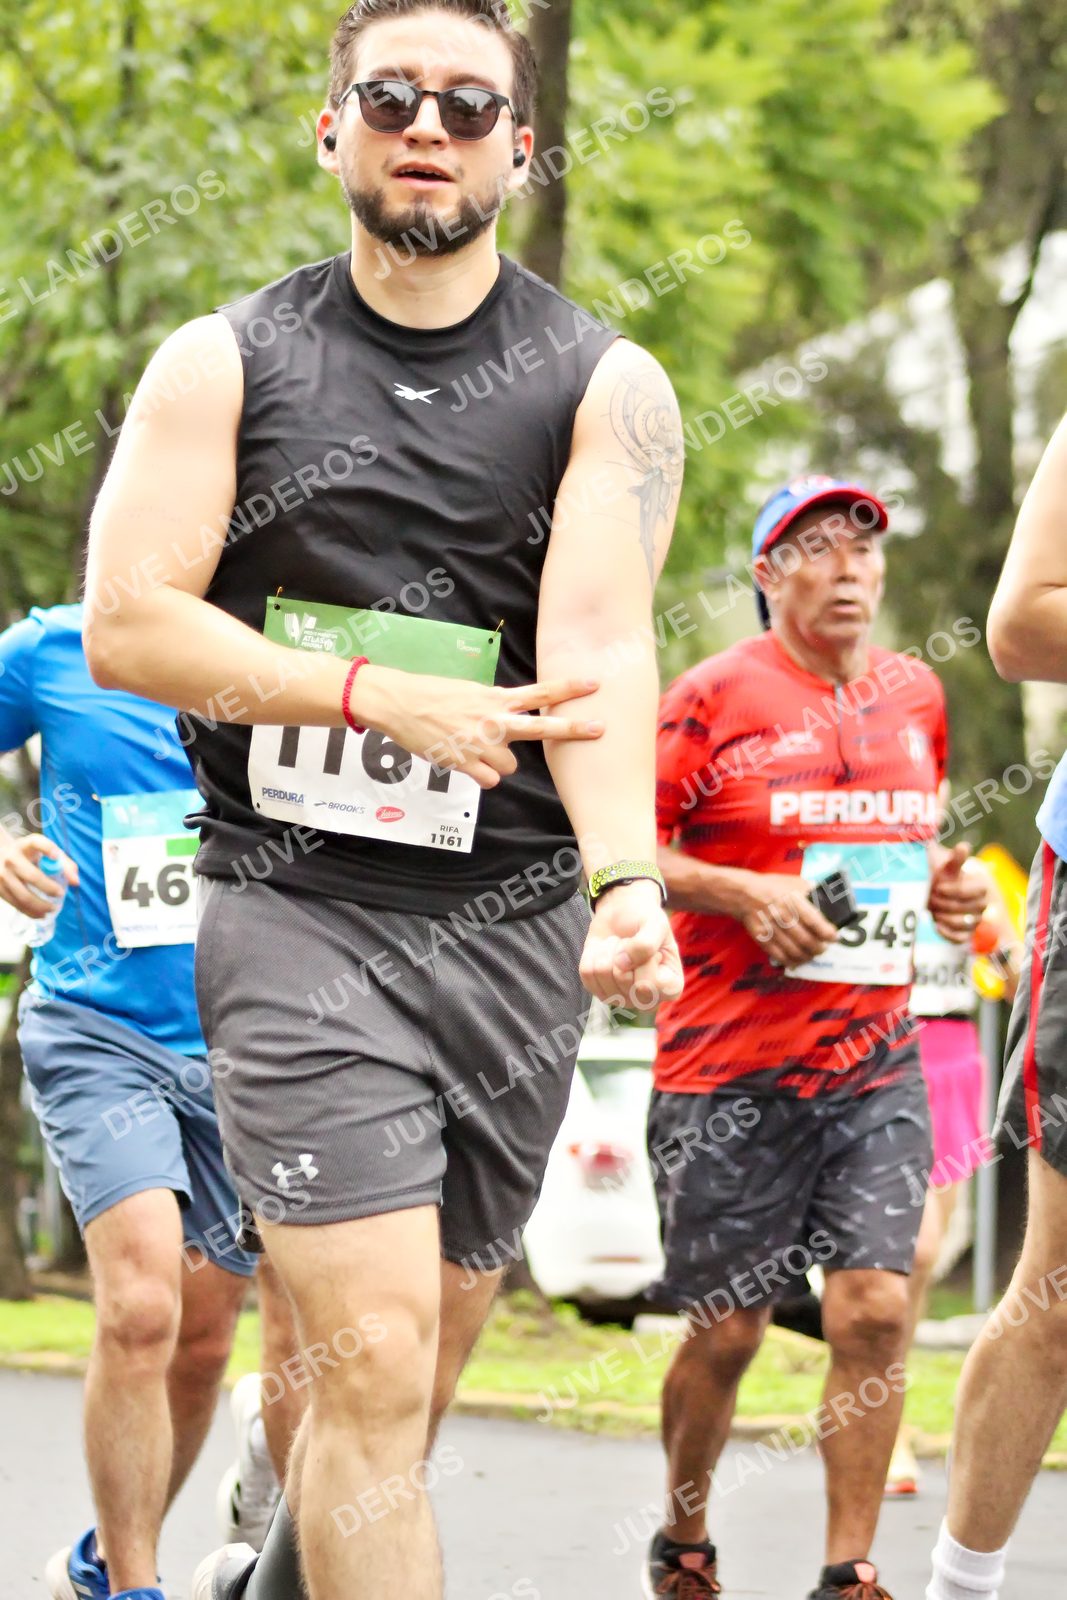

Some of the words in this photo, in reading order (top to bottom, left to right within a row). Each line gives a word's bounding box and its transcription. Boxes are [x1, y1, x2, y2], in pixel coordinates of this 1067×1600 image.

[302, 635, 325, 645] ATLAS
[262, 787, 305, 804] PERDURA
[327, 801, 366, 815] BROOKS
[440, 824, 460, 834] RIFA
[430, 832, 463, 848] 1161
[121, 861, 197, 908] 46
